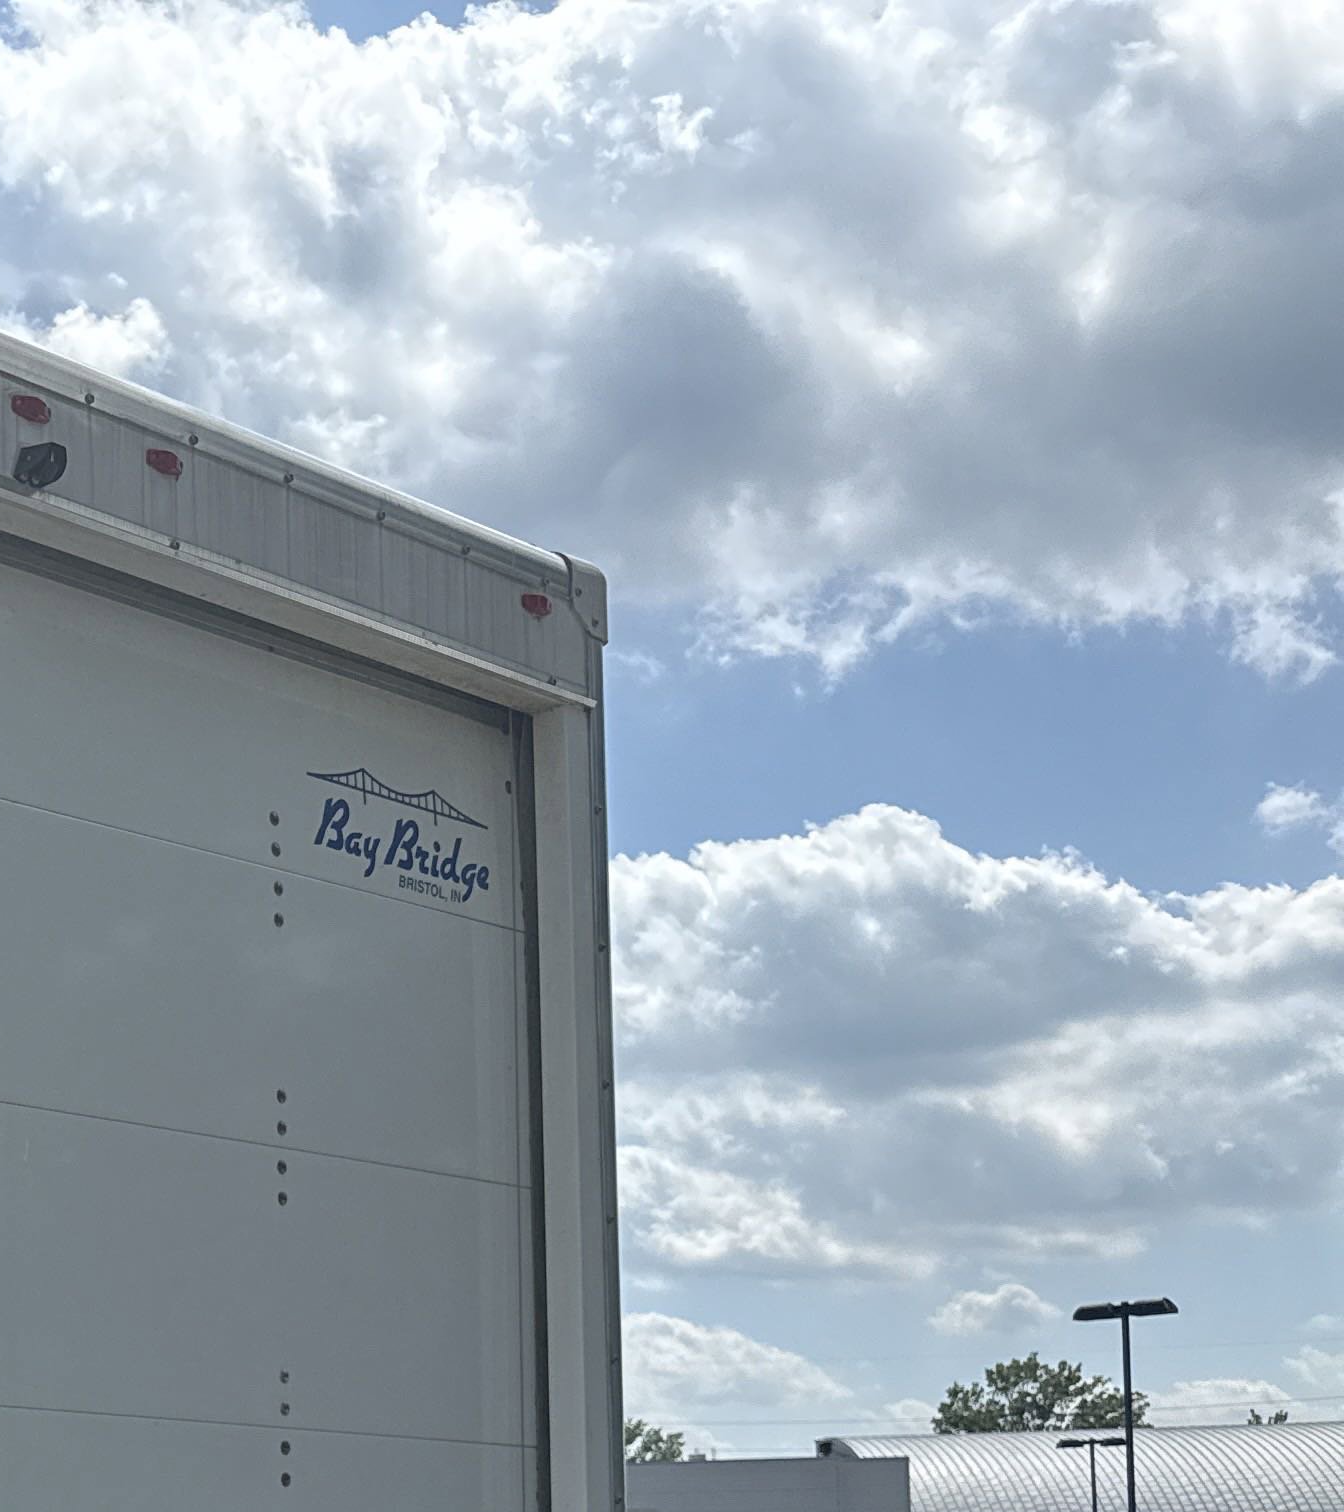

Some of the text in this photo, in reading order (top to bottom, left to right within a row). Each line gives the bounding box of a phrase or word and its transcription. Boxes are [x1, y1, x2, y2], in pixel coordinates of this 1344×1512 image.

[314, 798, 489, 902] Bay Bridge
[398, 875, 462, 903] BRISTOL, IN
